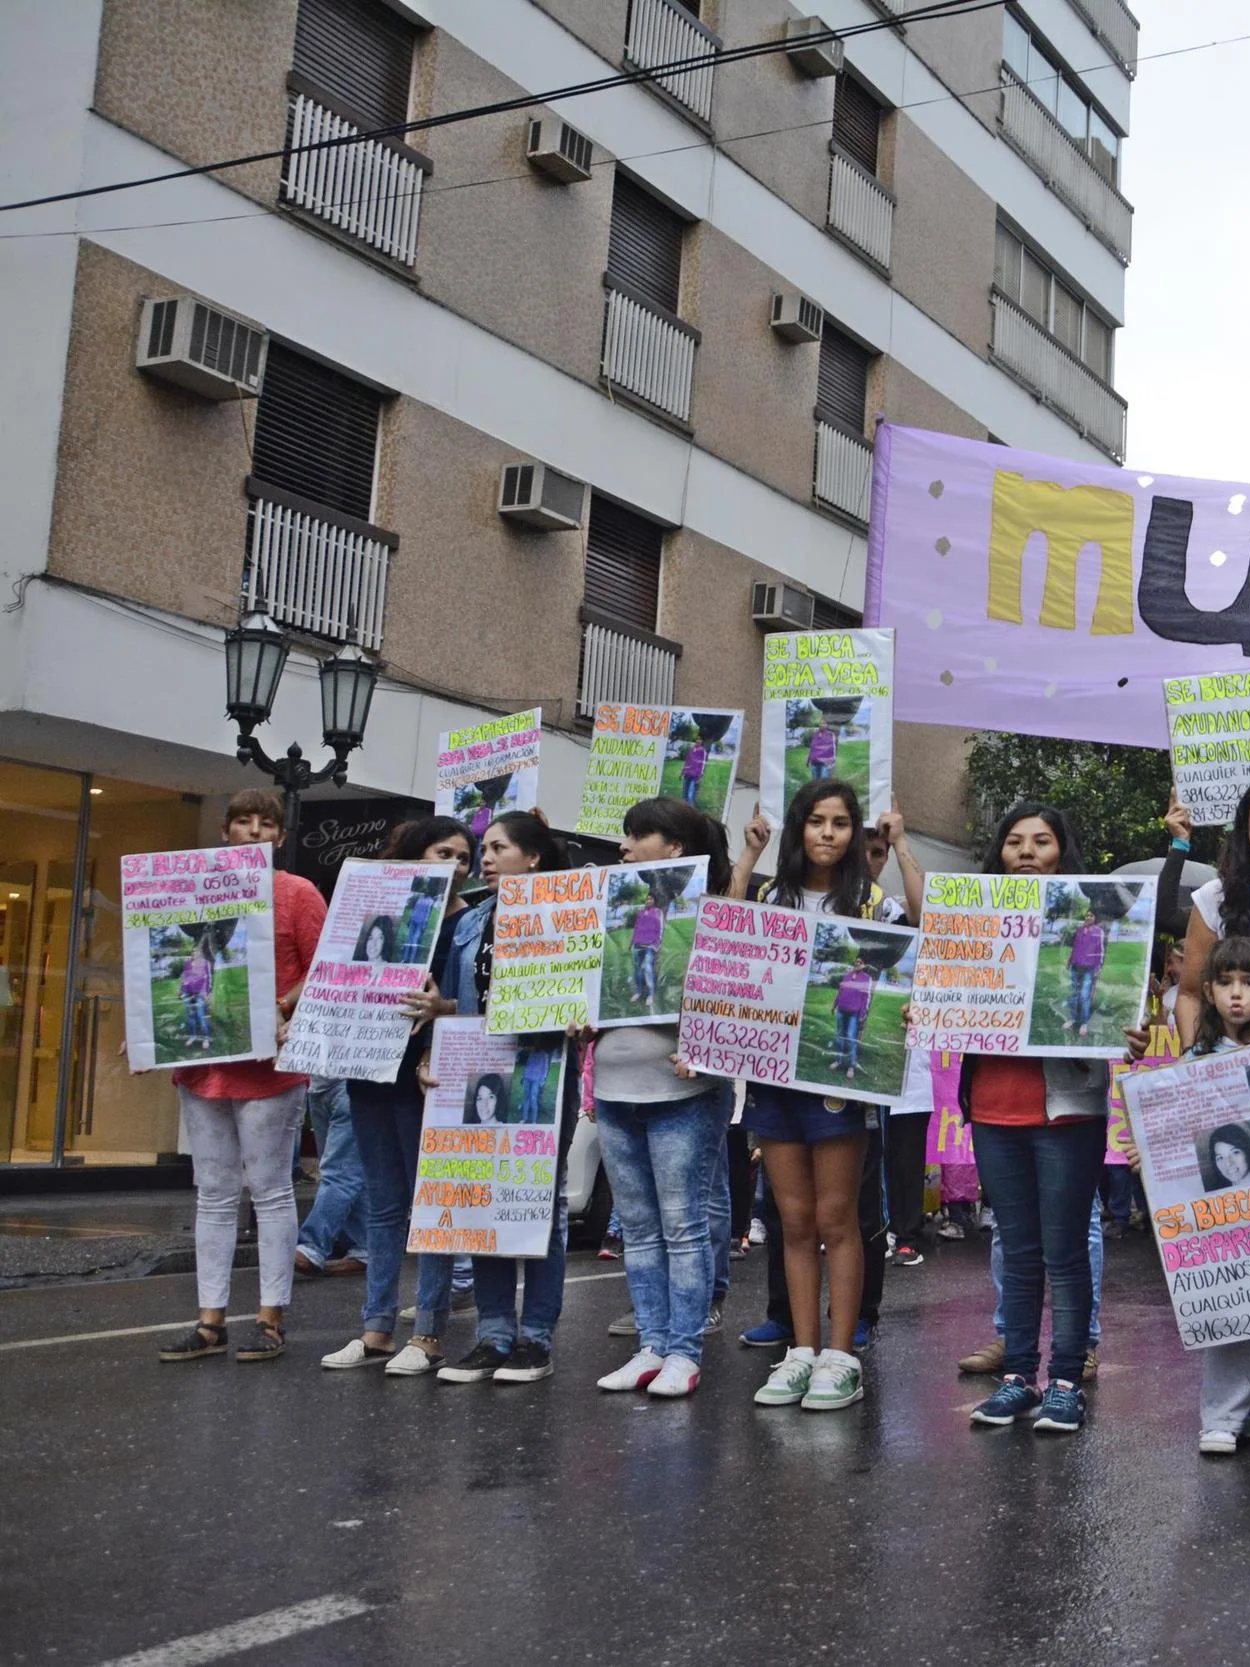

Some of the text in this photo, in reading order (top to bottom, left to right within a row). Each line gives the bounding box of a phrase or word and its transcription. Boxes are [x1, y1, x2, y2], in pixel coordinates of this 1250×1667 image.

[767, 634, 855, 660] SE BUSCA
[822, 661, 879, 686] VEGA
[1167, 679, 1196, 705] SE
[596, 705, 670, 737] SE BUSCA
[587, 758, 659, 781] ENCONTRARLA
[302, 819, 387, 848] Siamo
[123, 855, 148, 878] SE
[152, 852, 208, 876] BUSCA
[203, 871, 261, 890] 05 03 16
[501, 877, 528, 905] SE
[990, 877, 1041, 911] VEGA
[551, 907, 599, 933] VEGA
[761, 911, 808, 943] VEGA
[918, 937, 1016, 963] AYUDANOS A
[690, 955, 773, 985] AYUDANOS A
[683, 997, 736, 1018] CUALQUIER
[681, 1016, 790, 1055] 3816322621
[907, 1027, 1020, 1052] 3813579692
[680, 1041, 790, 1084] 3813579692
[498, 1129, 511, 1154] A
[497, 1159, 510, 1183] 5
[513, 1159, 526, 1185] 3
[531, 1161, 553, 1185] 16
[415, 1180, 493, 1208] AYUDANOS
[438, 1207, 453, 1228] A
[1154, 1203, 1193, 1239] SE
[409, 1227, 497, 1252] ENCONTRARLA
